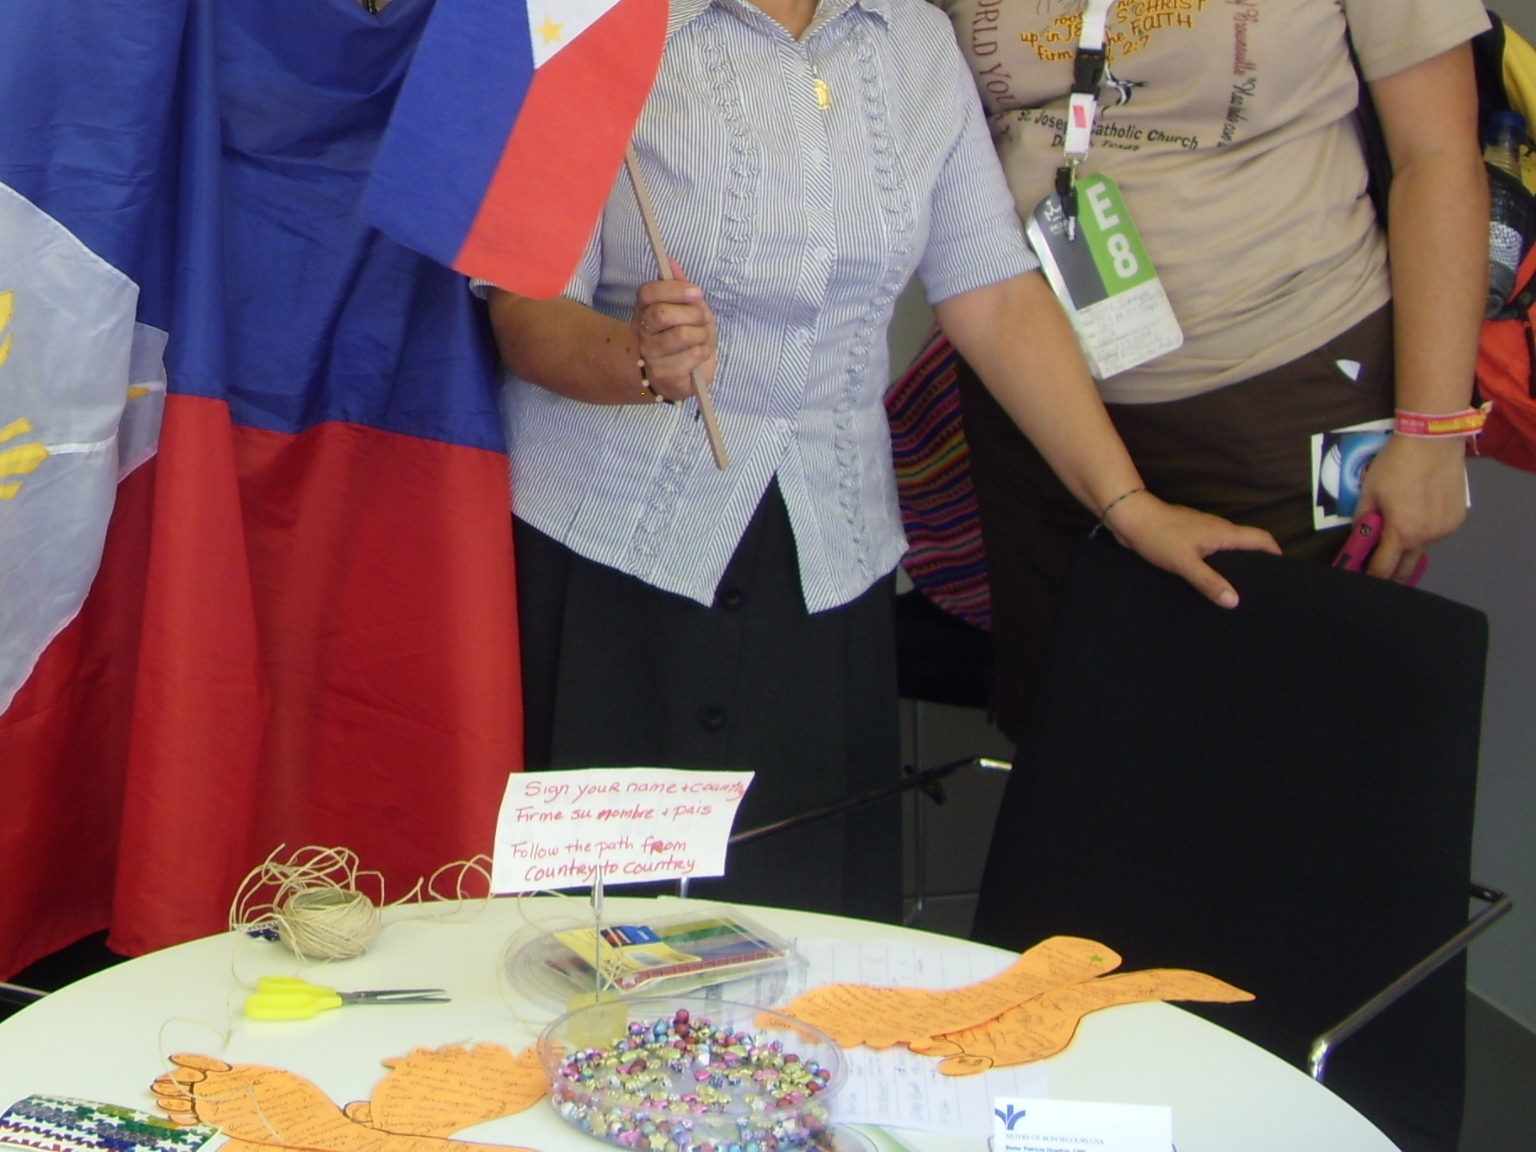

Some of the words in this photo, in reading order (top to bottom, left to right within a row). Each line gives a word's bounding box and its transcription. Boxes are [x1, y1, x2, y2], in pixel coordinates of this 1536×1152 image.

[1020, 31, 1039, 47] up
[1046, 30, 1061, 43] in
[1037, 45, 1073, 61] firm
[1130, 12, 1193, 36] FAITH
[1146, 129, 1199, 152] Church
[524, 780, 569, 804] Sign
[626, 782, 678, 794] name
[516, 805, 565, 823] Firme
[570, 808, 592, 821] su
[511, 842, 559, 860] Follow
[564, 839, 592, 854] the
[594, 836, 634, 859] path
